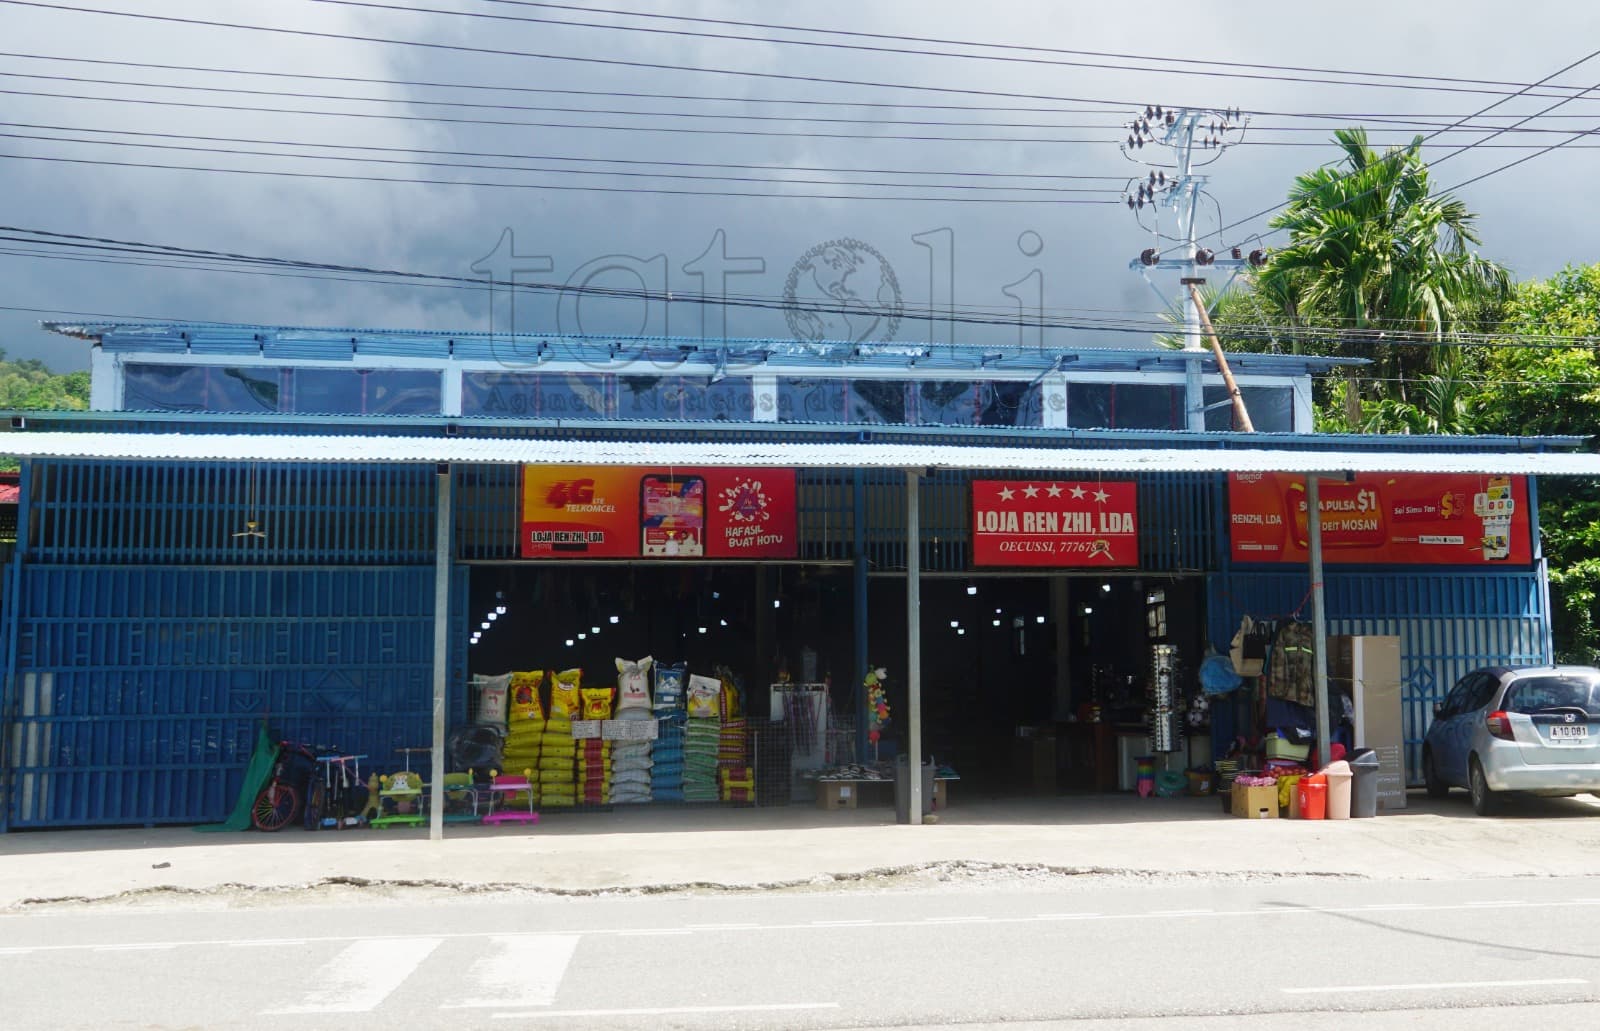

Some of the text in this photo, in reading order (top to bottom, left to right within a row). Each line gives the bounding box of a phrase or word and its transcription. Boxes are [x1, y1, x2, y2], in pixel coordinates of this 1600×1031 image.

[544, 478, 596, 509] 4G
[1326, 501, 1356, 511] PULSA
[1357, 489, 1376, 512] $1
[566, 504, 616, 513] TELKOMCEL
[976, 511, 1135, 535] LOJA REN ZHI, LDA
[1231, 513, 1282, 525] RENZHI, LDA
[1341, 518, 1378, 531] MOSAN
[532, 530, 553, 543] LOJA
[554, 530, 570, 543] REN
[588, 530, 604, 543] LDA
[728, 534, 783, 548] BUAT HOTU
[999, 541, 1056, 554] OECUSSI,
